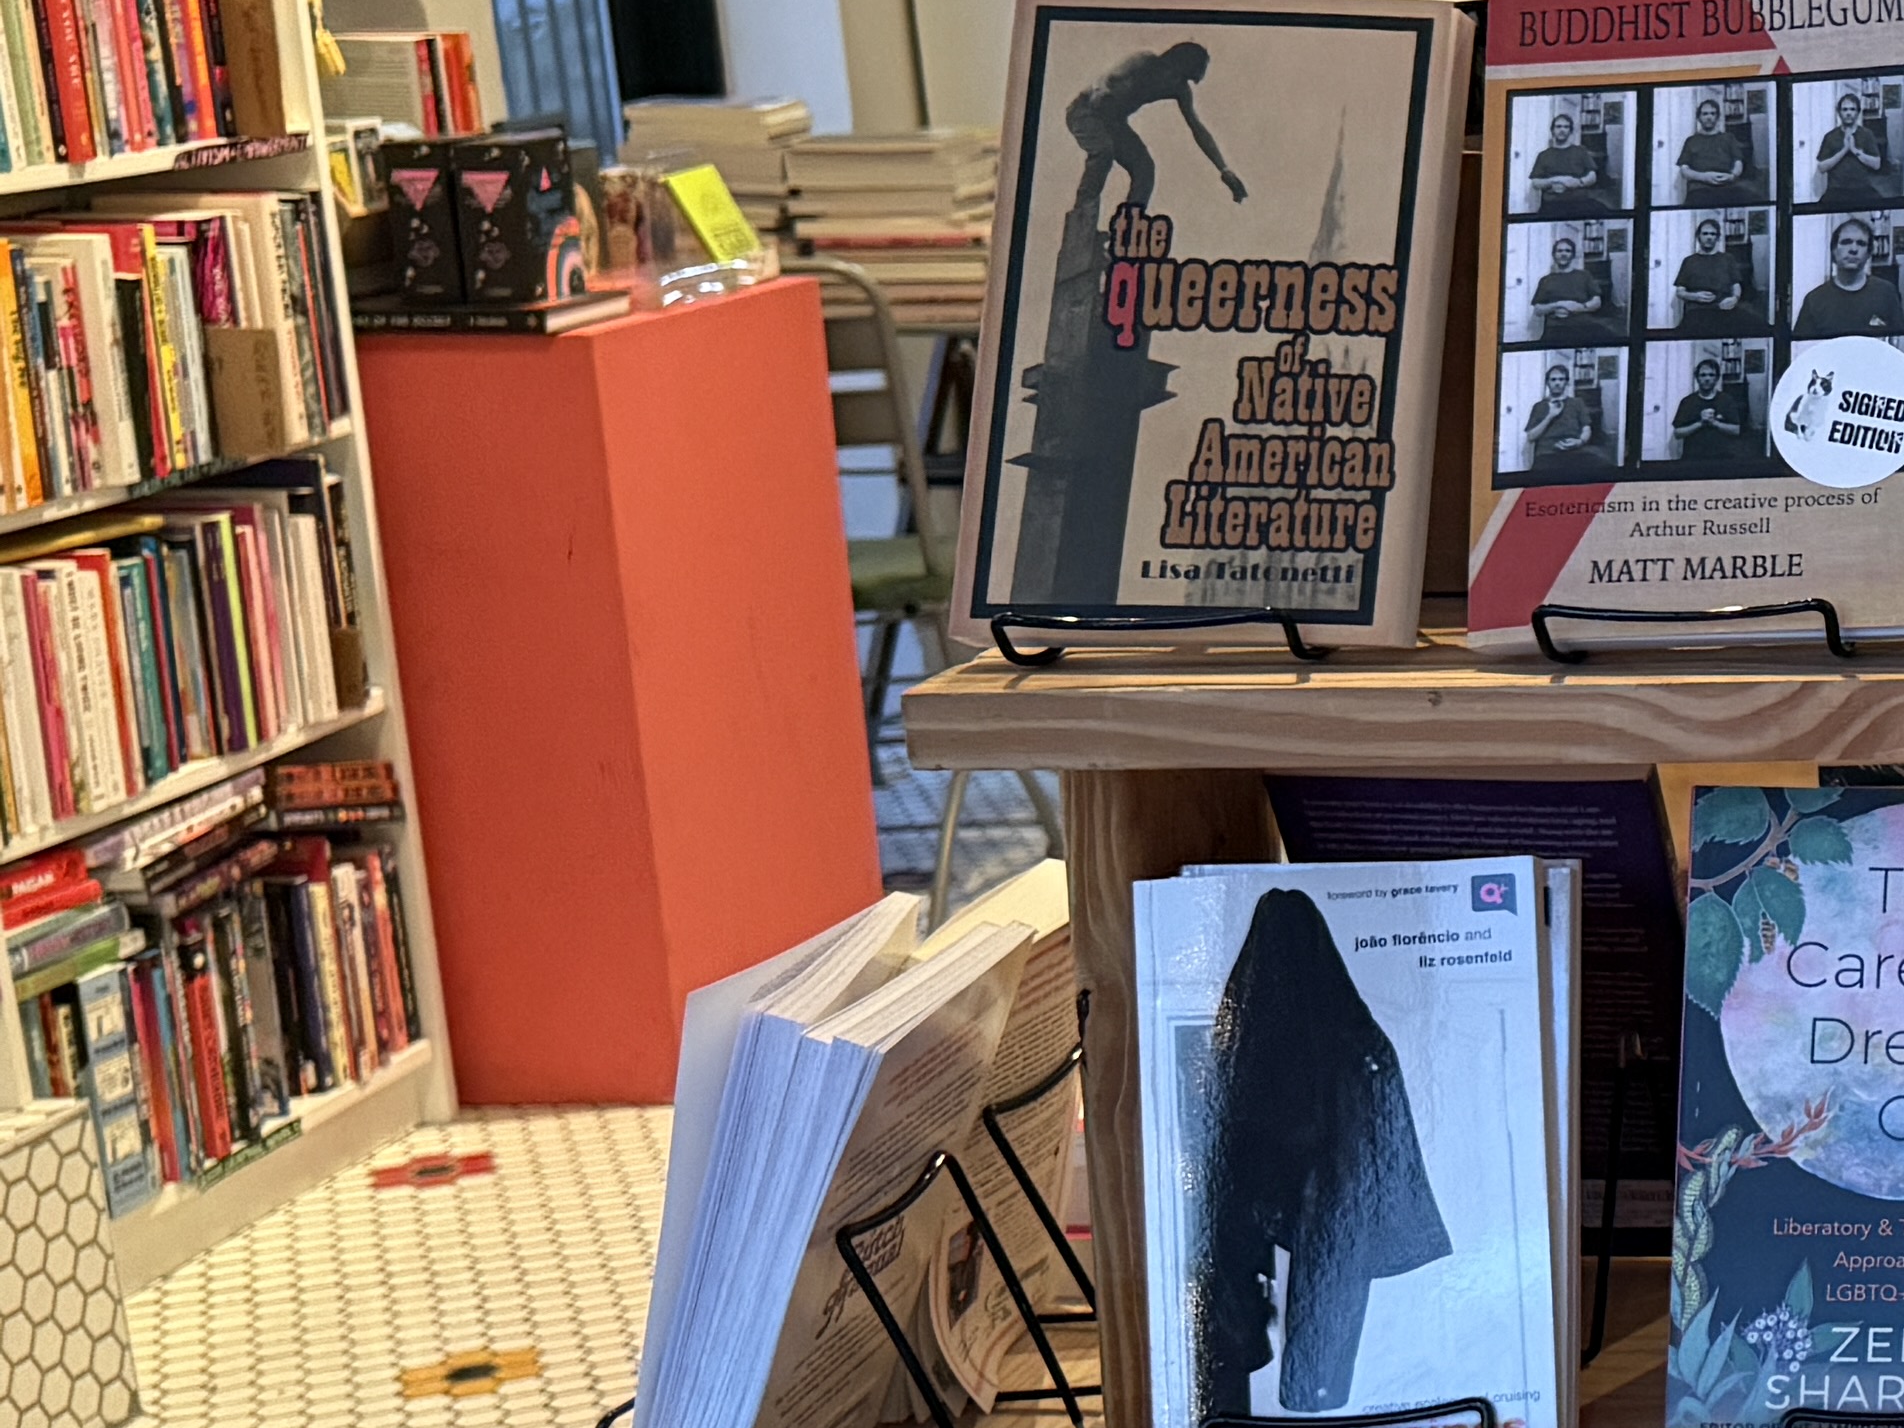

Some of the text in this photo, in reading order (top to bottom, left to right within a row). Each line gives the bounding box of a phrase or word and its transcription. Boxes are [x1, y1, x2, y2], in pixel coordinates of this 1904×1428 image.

[1518, 0, 1691, 48] BUDDHIST
[1110, 204, 1171, 260] the
[1104, 260, 1399, 351] queerness
[1278, 333, 1309, 373] of
[1234, 358, 1376, 426] Native
[1192, 419, 1395, 489] American
[1828, 420, 1904, 455] EDITION
[1161, 481, 1378, 551] Literature
[1631, 517, 1771, 539] Arthur Russell
[1141, 559, 1356, 584] Lisa Tatonetti
[1589, 553, 1803, 584] MATT MARBLE
